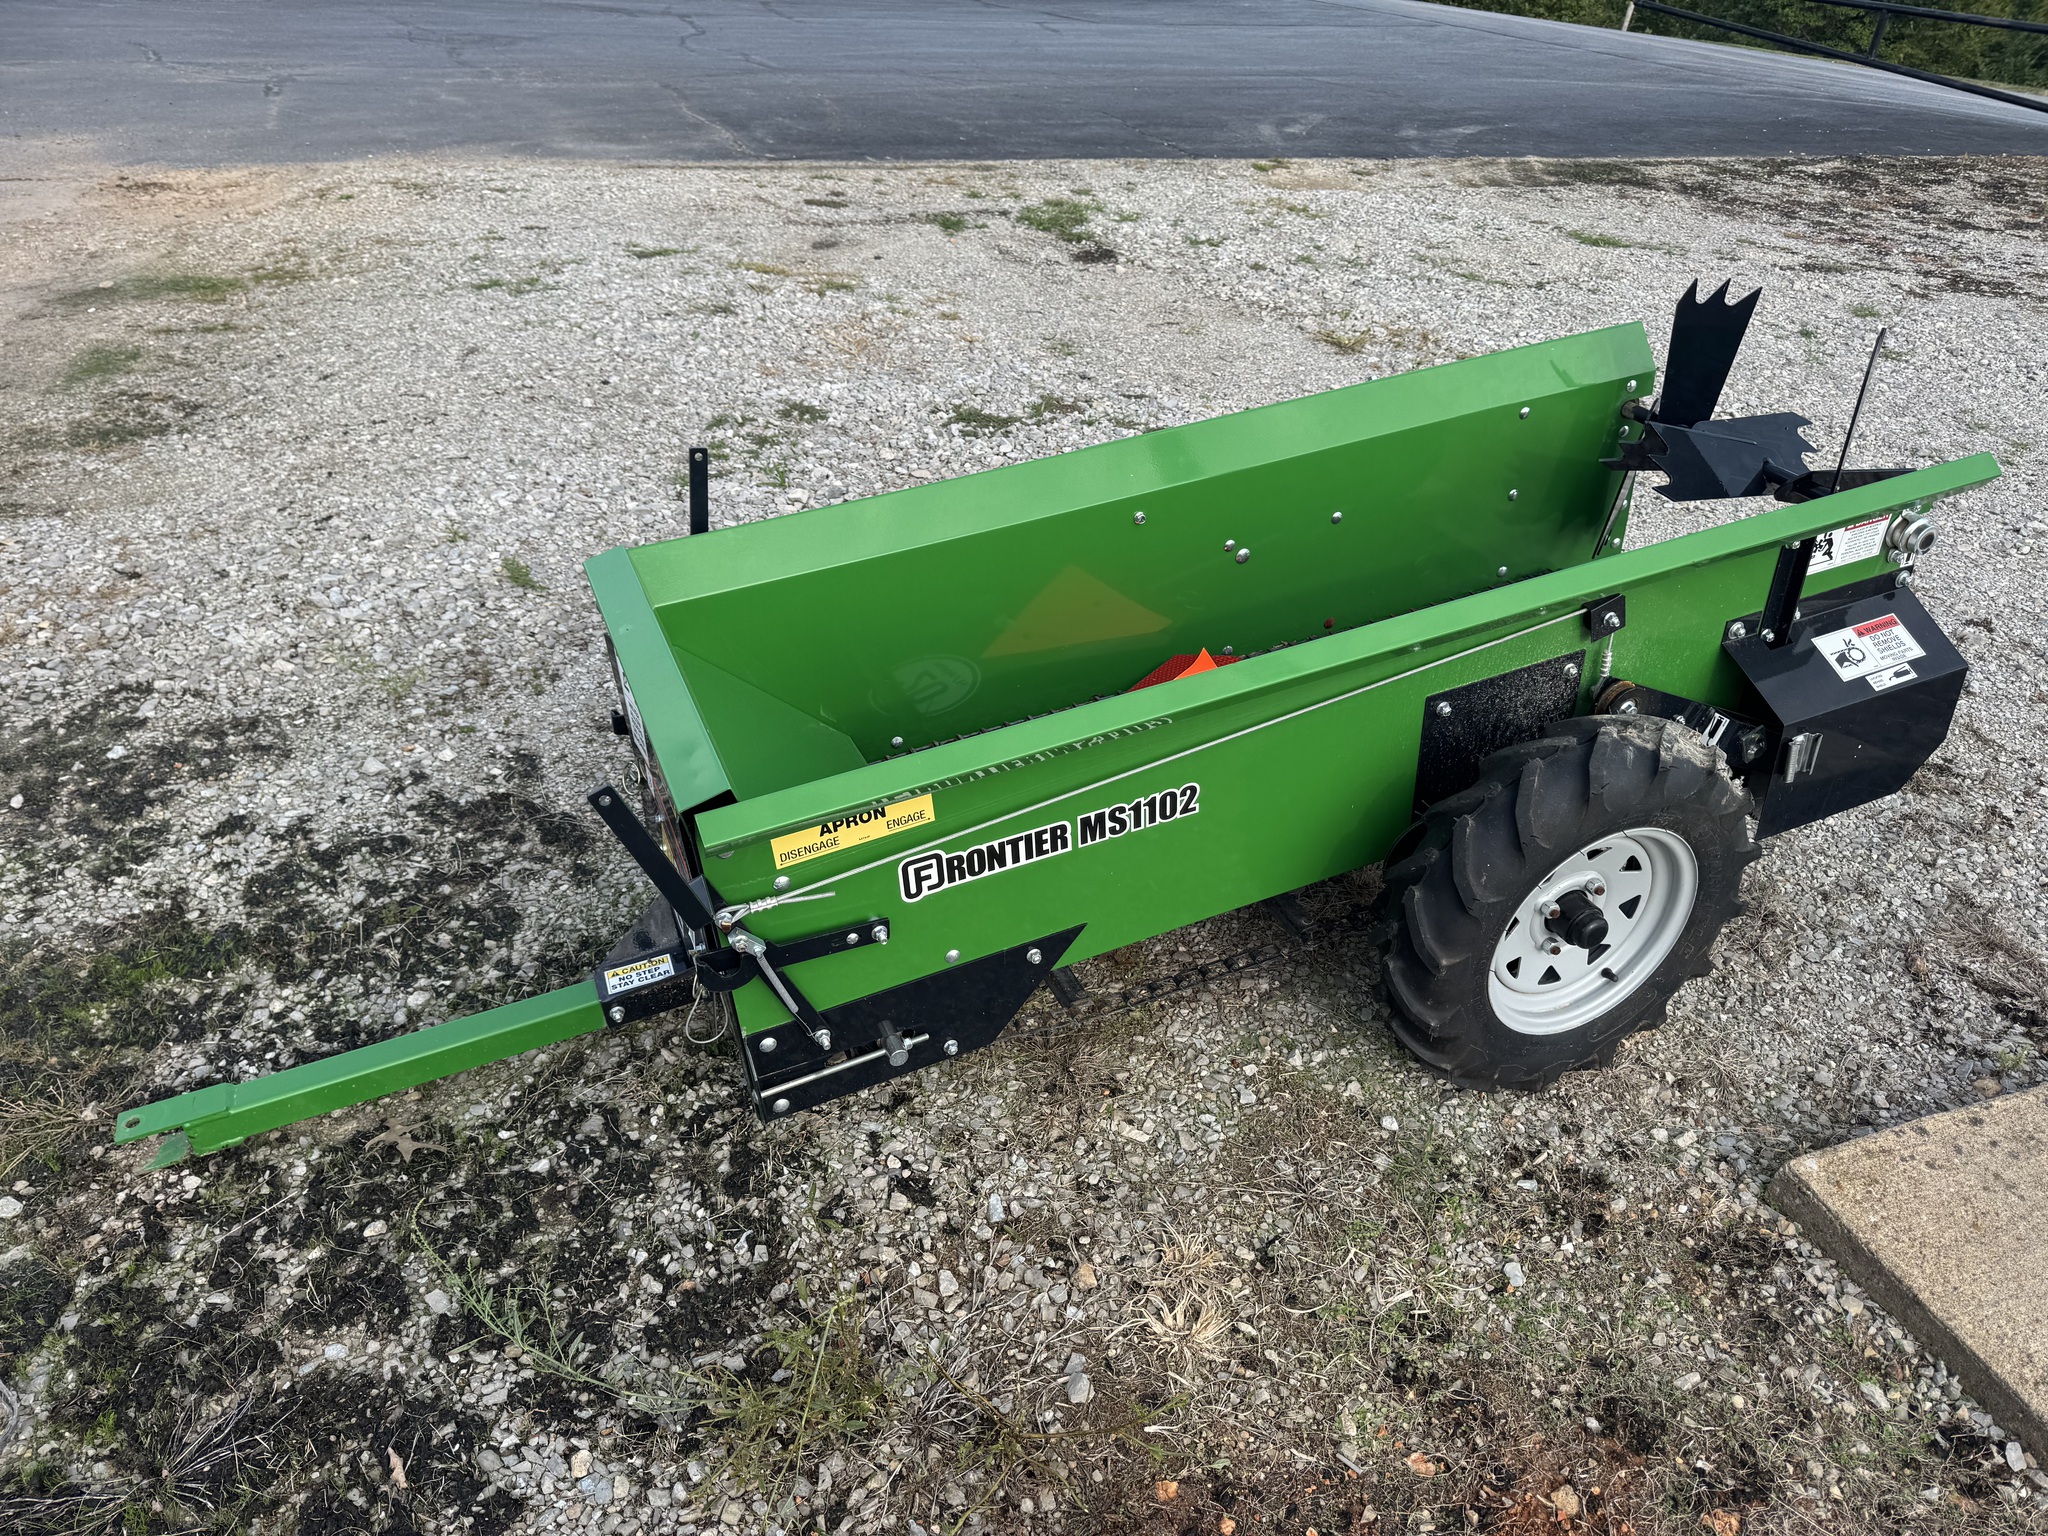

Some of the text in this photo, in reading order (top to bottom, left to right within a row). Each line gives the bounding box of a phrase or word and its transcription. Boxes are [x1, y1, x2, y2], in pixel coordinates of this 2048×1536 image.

[1863, 619, 1897, 633] WARNING
[1869, 629, 1895, 642] DO NOT
[1872, 634, 1901, 648] REMOVE
[1877, 641, 1906, 654] SHIELDS
[819, 806, 887, 837] APRON
[779, 809, 926, 863] DISENGAGE ENGAGE
[901, 784, 1198, 900] FRONTIER MS1102
[611, 969, 671, 991] STAY CLEAR
[618, 966, 661, 982] NO STEP
